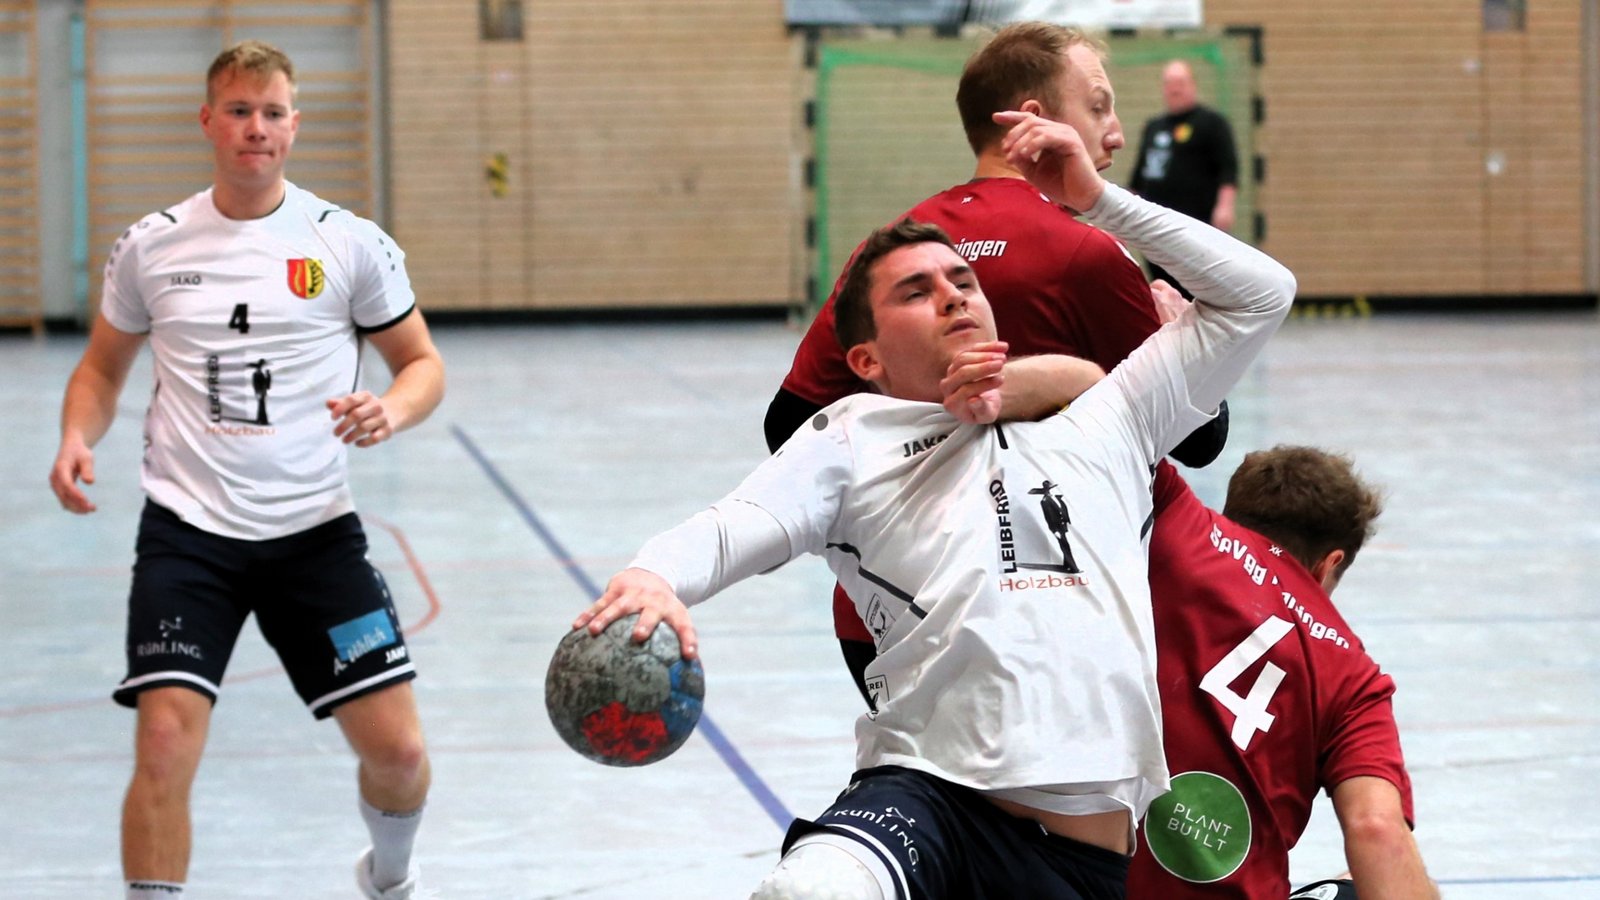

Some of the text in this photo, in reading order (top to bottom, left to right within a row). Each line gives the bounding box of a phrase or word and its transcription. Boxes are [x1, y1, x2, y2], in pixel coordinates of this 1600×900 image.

[228, 303, 250, 334] 4
[1000, 575, 1089, 592] Holzbau
[1198, 614, 1296, 751] 4
[1167, 817, 1227, 851] BUILT
[1173, 802, 1233, 837] PLANT
